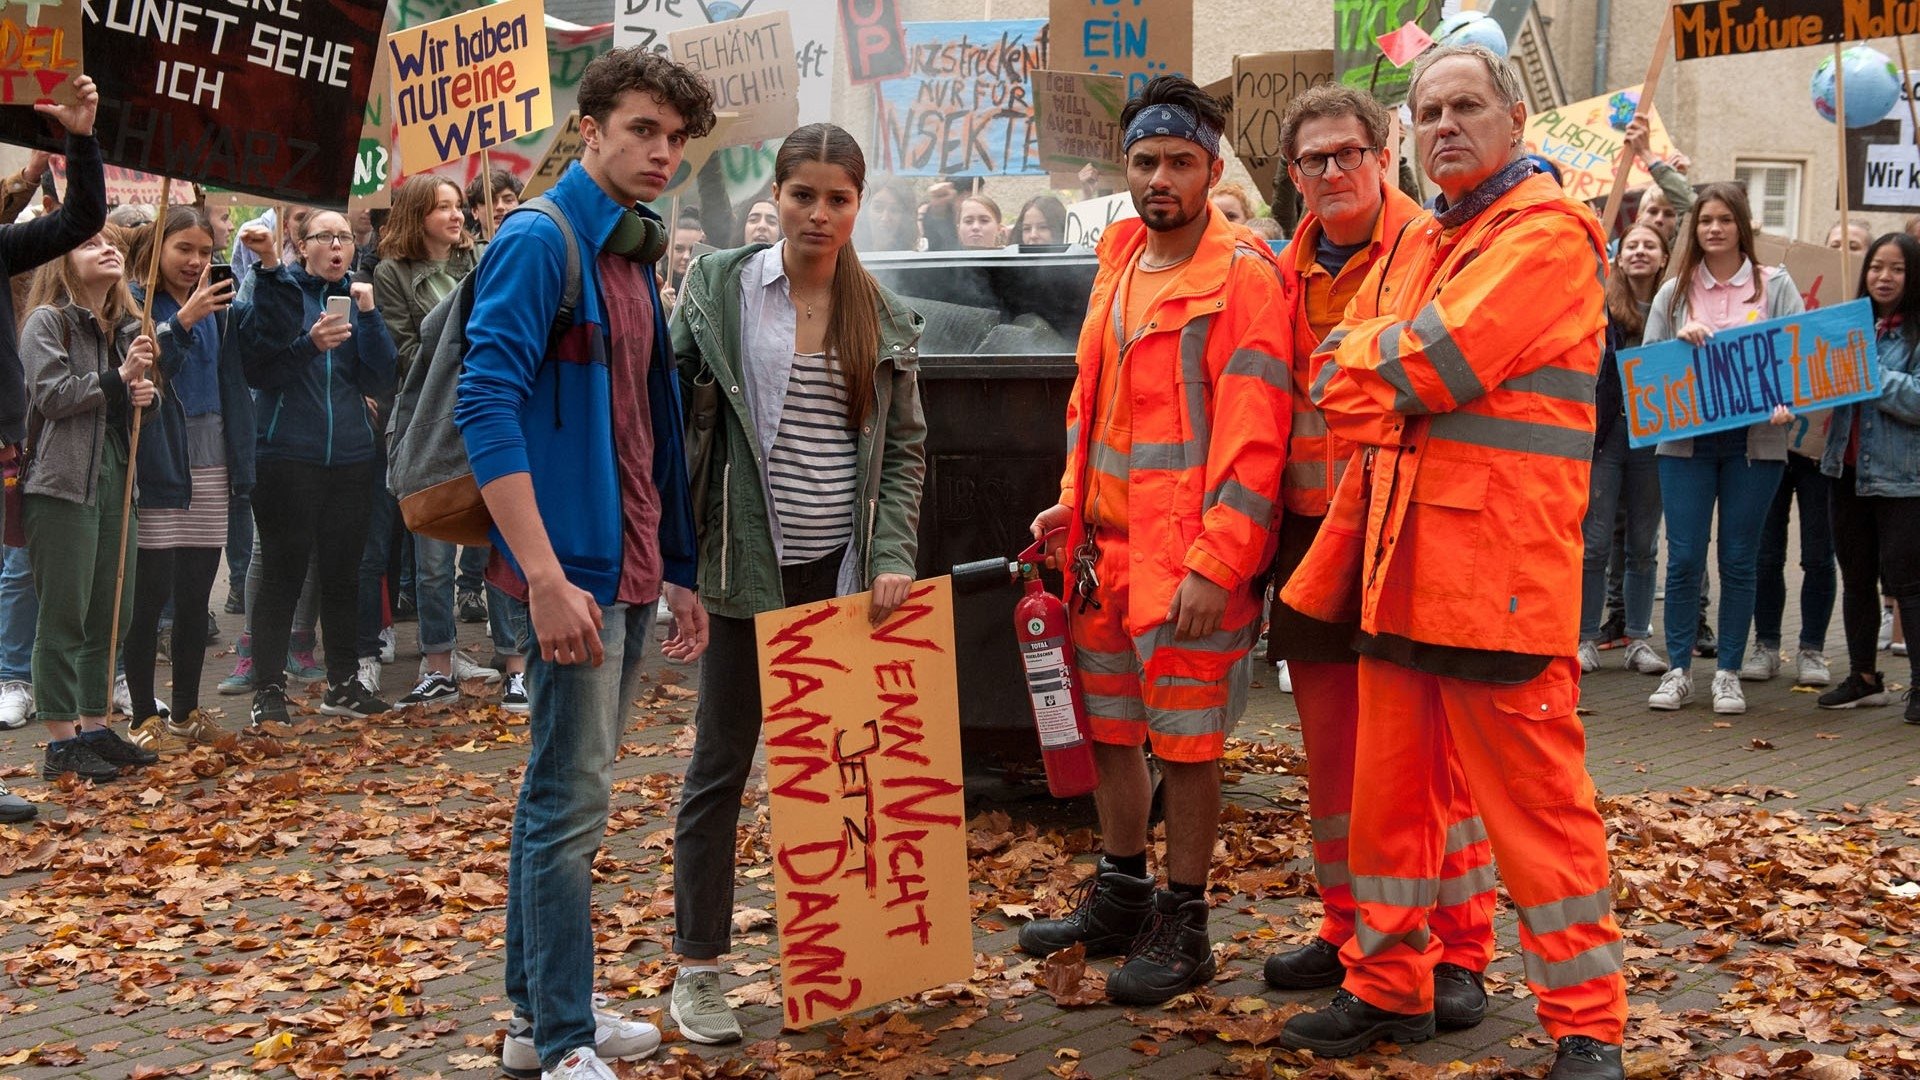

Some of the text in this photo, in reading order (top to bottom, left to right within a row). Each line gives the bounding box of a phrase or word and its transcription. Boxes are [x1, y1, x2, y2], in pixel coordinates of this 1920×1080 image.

[247, 21, 354, 88] SEHE
[389, 29, 449, 82] Wir
[454, 14, 529, 67] haben
[684, 22, 782, 72] SCHÄMT
[155, 60, 224, 110] ICH
[398, 74, 452, 127] nur
[451, 60, 517, 109] eine
[711, 65, 787, 110] UCH!!!
[428, 87, 540, 162] WELT
[1238, 107, 1286, 157] KO
[1533, 110, 1624, 164] PLASTIK
[1543, 138, 1606, 170] WELT
[1867, 161, 1903, 188] Wir
[1622, 323, 1874, 439] Es ist UNSERE Zukunft
[1031, 641, 1049, 650] TOTAL
[764, 601, 853, 804] WANN
[870, 585, 964, 946] WENN NICHT
[832, 719, 880, 899] JETZT
